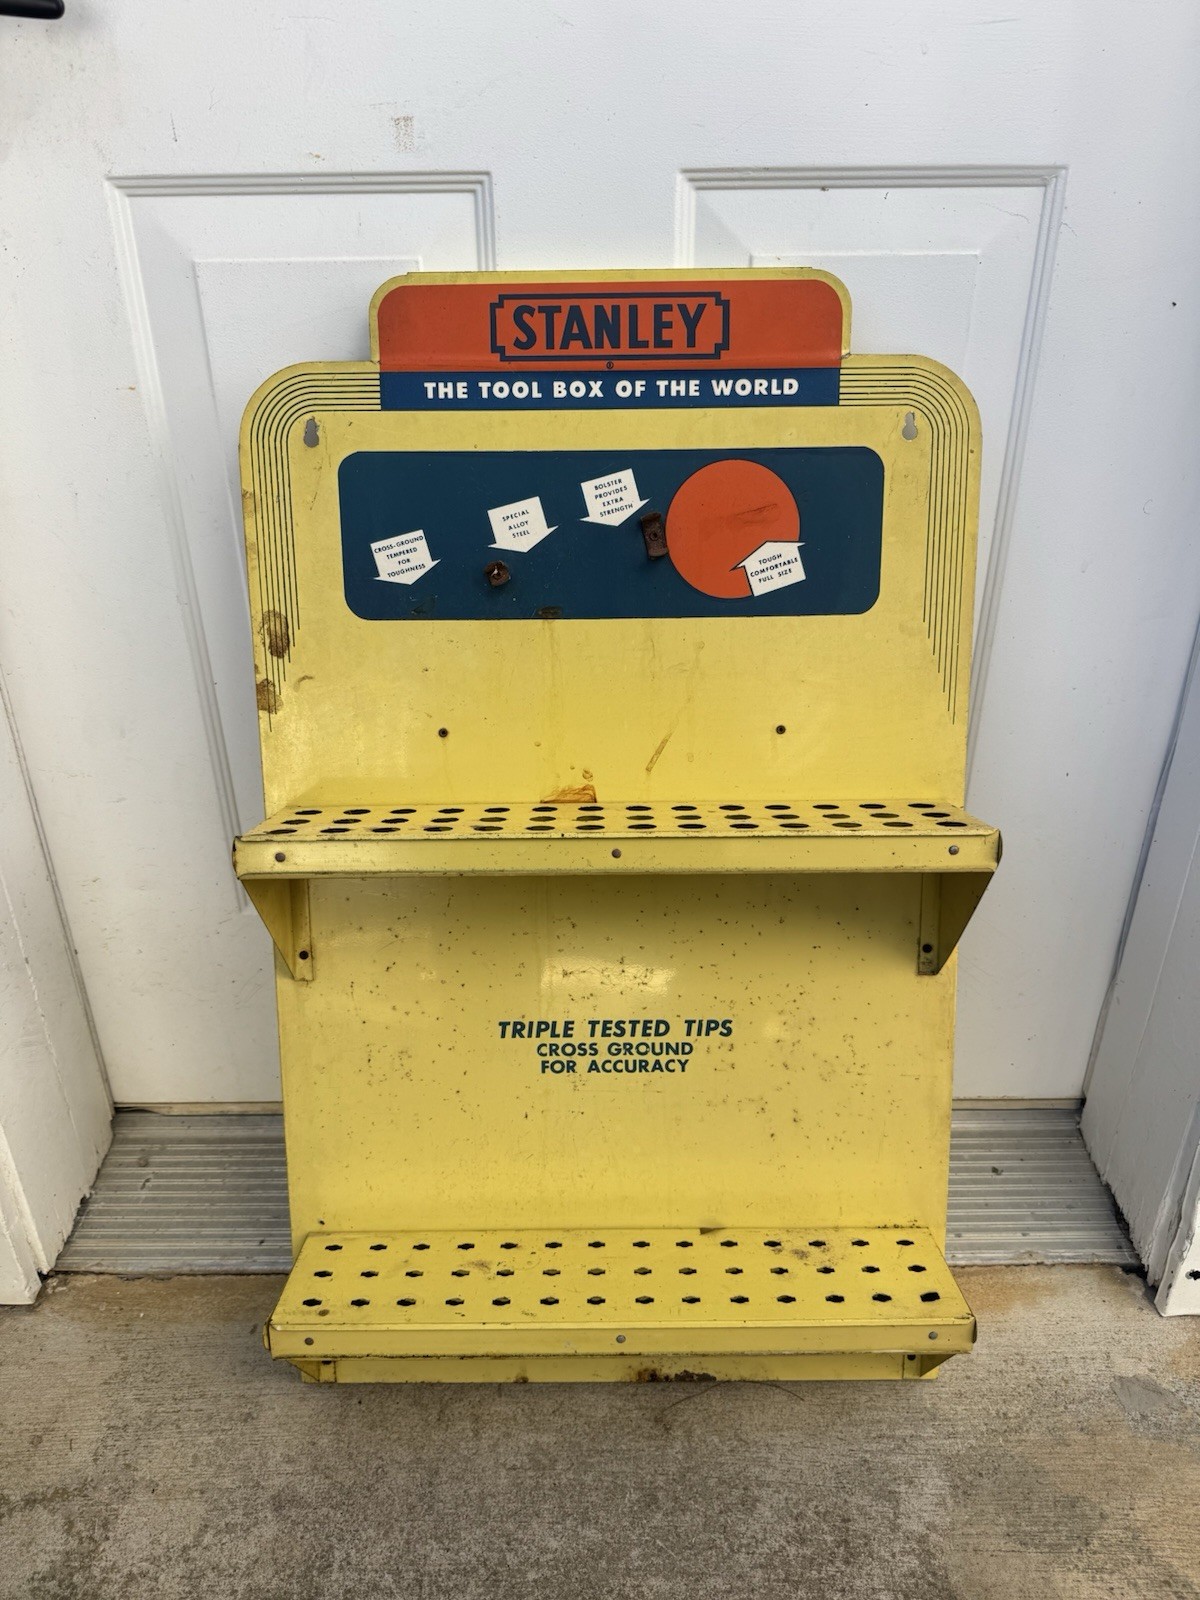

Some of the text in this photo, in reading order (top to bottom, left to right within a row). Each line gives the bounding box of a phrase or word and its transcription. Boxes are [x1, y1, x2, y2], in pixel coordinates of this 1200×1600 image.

[512, 303, 707, 350] STANLEY
[424, 378, 800, 399] THE TOOL BOX OF THE WORLD
[594, 478, 622, 491] BOLSTER
[594, 485, 628, 500] PROVIDES
[602, 496, 624, 507] EXTRA
[502, 509, 530, 522] SPECIAL
[599, 503, 634, 518] STRENGTH
[508, 520, 529, 531] ALLOY
[512, 529, 530, 539] STEEL
[373, 535, 424, 554] CROSS-GROUND
[386, 547, 418, 560] TEMPERED
[758, 553, 783, 565] TOUGH
[398, 558, 411, 566] FOR
[750, 557, 799, 578] COMFORTABLE
[387, 563, 426, 578] TOUGHNESS
[758, 568, 792, 584] FULL SIZE
[498, 1018, 734, 1038] TRIPLE TESTED TIPS
[536, 1042, 694, 1057] CROSS GROUND
[540, 1058, 690, 1074] FOR ACCURACY
